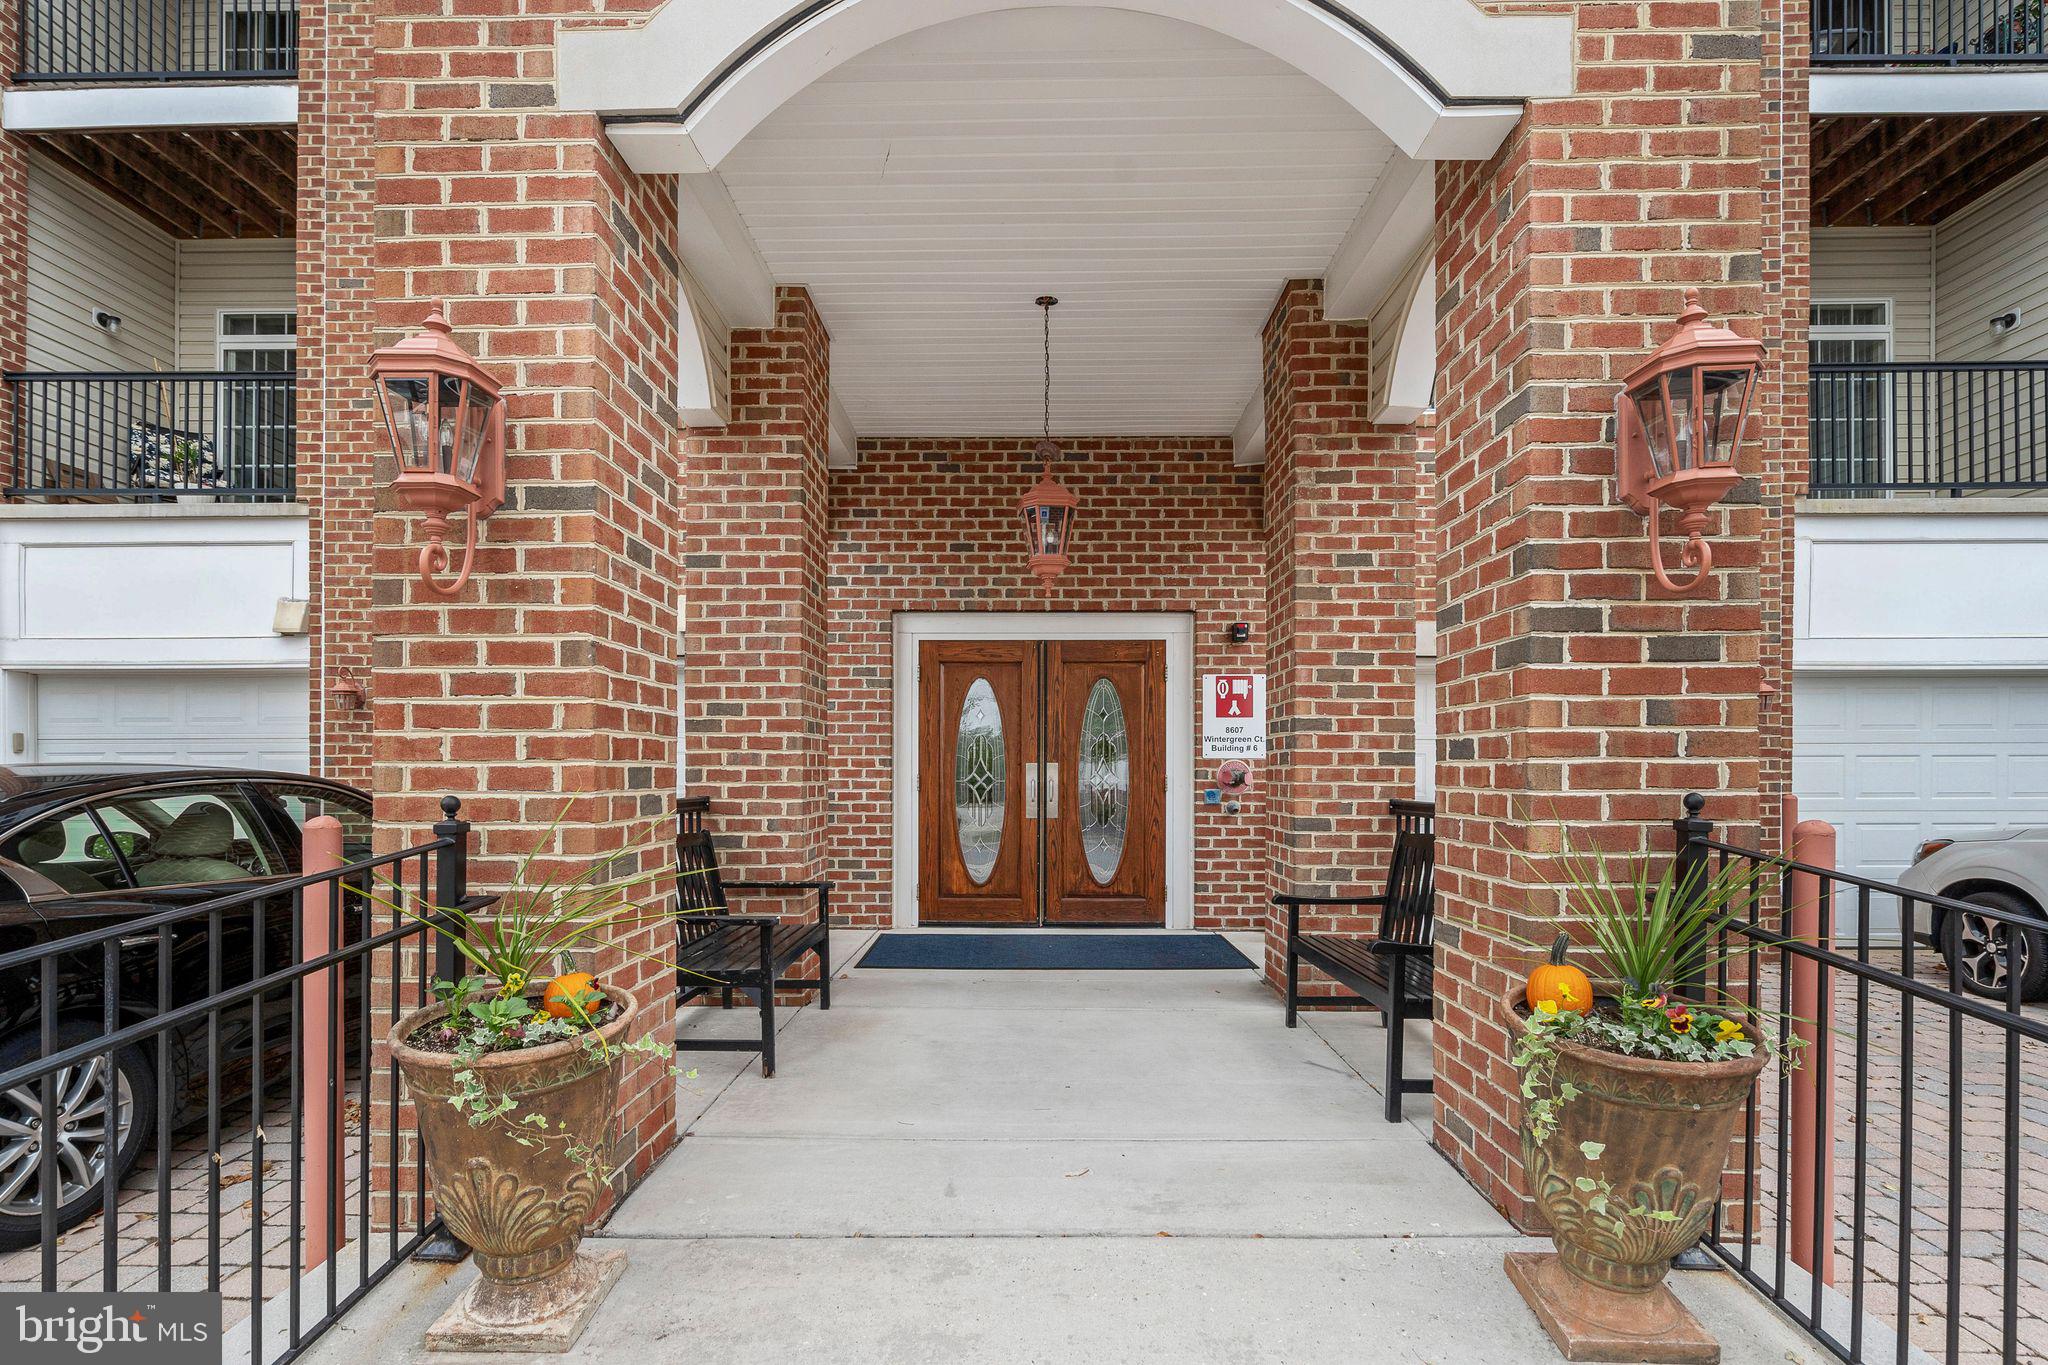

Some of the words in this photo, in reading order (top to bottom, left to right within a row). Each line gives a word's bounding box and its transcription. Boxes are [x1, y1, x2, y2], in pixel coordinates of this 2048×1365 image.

[1225, 726, 1244, 734] 8607
[1204, 736, 1252, 744] Wintergreen
[1211, 745, 1244, 753] Building
